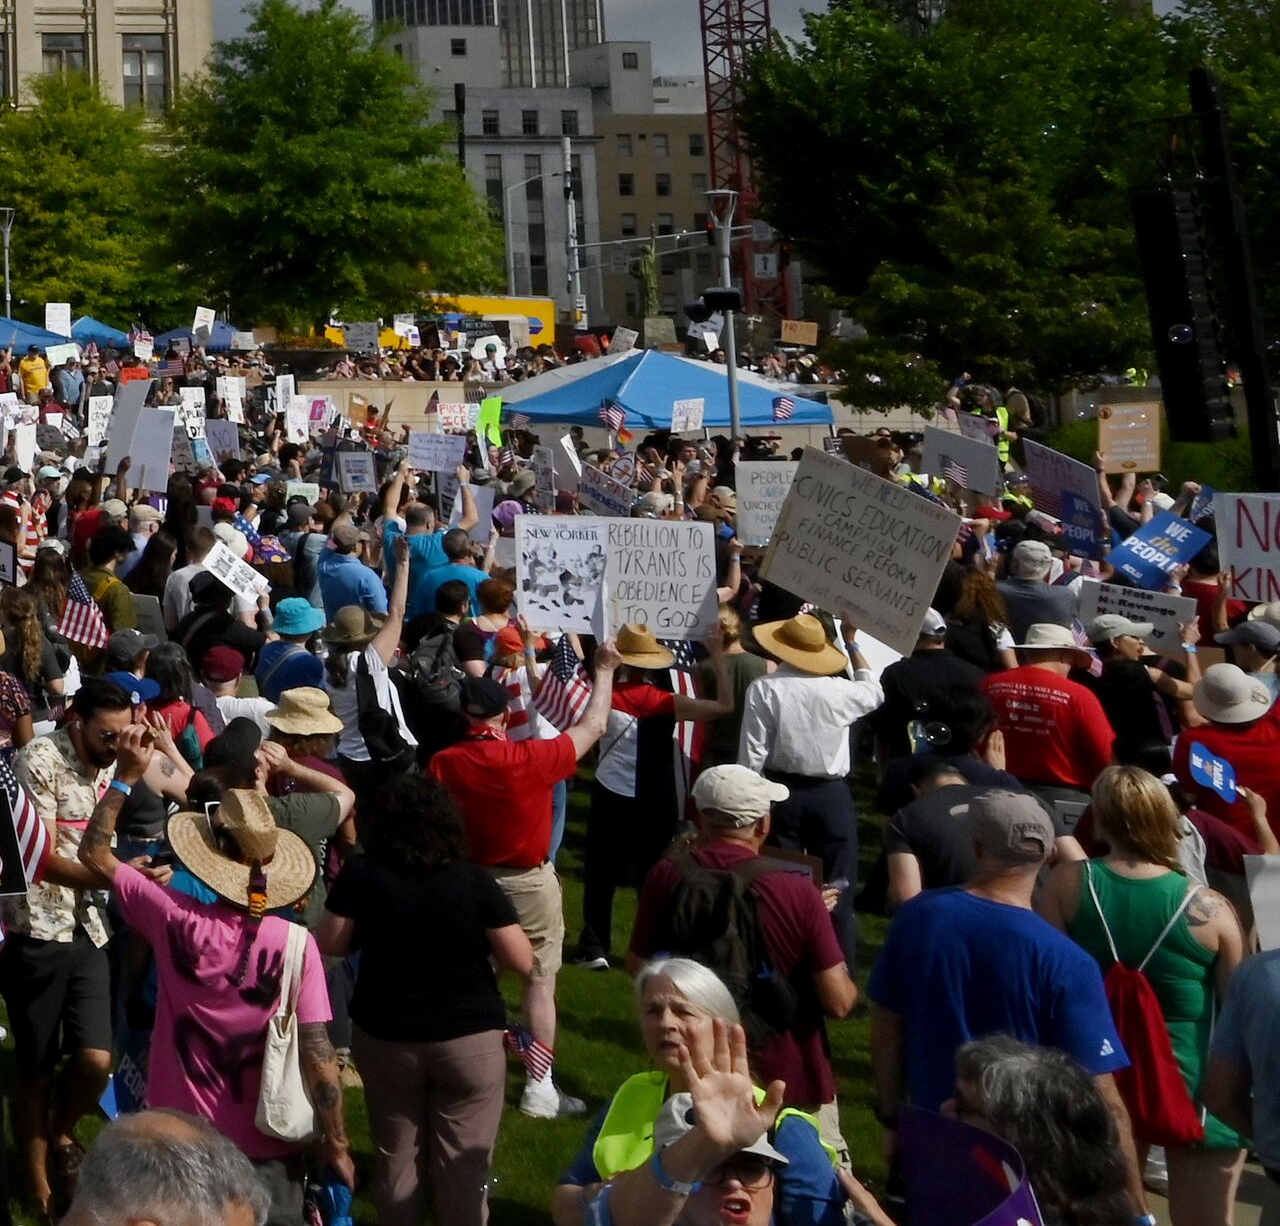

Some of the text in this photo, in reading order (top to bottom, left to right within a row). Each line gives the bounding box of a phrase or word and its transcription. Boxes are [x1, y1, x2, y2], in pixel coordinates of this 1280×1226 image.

[438, 404, 466, 414] FUCK
[443, 416, 468, 426] ICE
[751, 470, 793, 485] PEOPLE
[850, 471, 874, 491] WE
[877, 484, 910, 511] NEED
[743, 501, 782, 511] UNCHEC
[795, 476, 949, 563] CIVICS EDUCATION
[526, 528, 598, 541] NEW YORKER
[608, 523, 703, 549] REBELLION TO
[824, 512, 897, 557] CAMPAIGN
[1061, 524, 1096, 543] PEOPL
[1164, 521, 1193, 543] WE
[798, 518, 918, 590] FINANCE REFORM
[1149, 536, 1179, 555] the
[614, 547, 712, 578] TYRANTS IS
[778, 533, 921, 618] PUBLIC SERVANTS
[1229, 564, 1280, 603] KIN
[616, 580, 702, 605] OBEDIENCE
[1122, 585, 1154, 601] Hate
[623, 605, 700, 629] TO GOD
[1118, 598, 1177, 617] Revenge
[1212, 759, 1224, 791] PEOPLE
